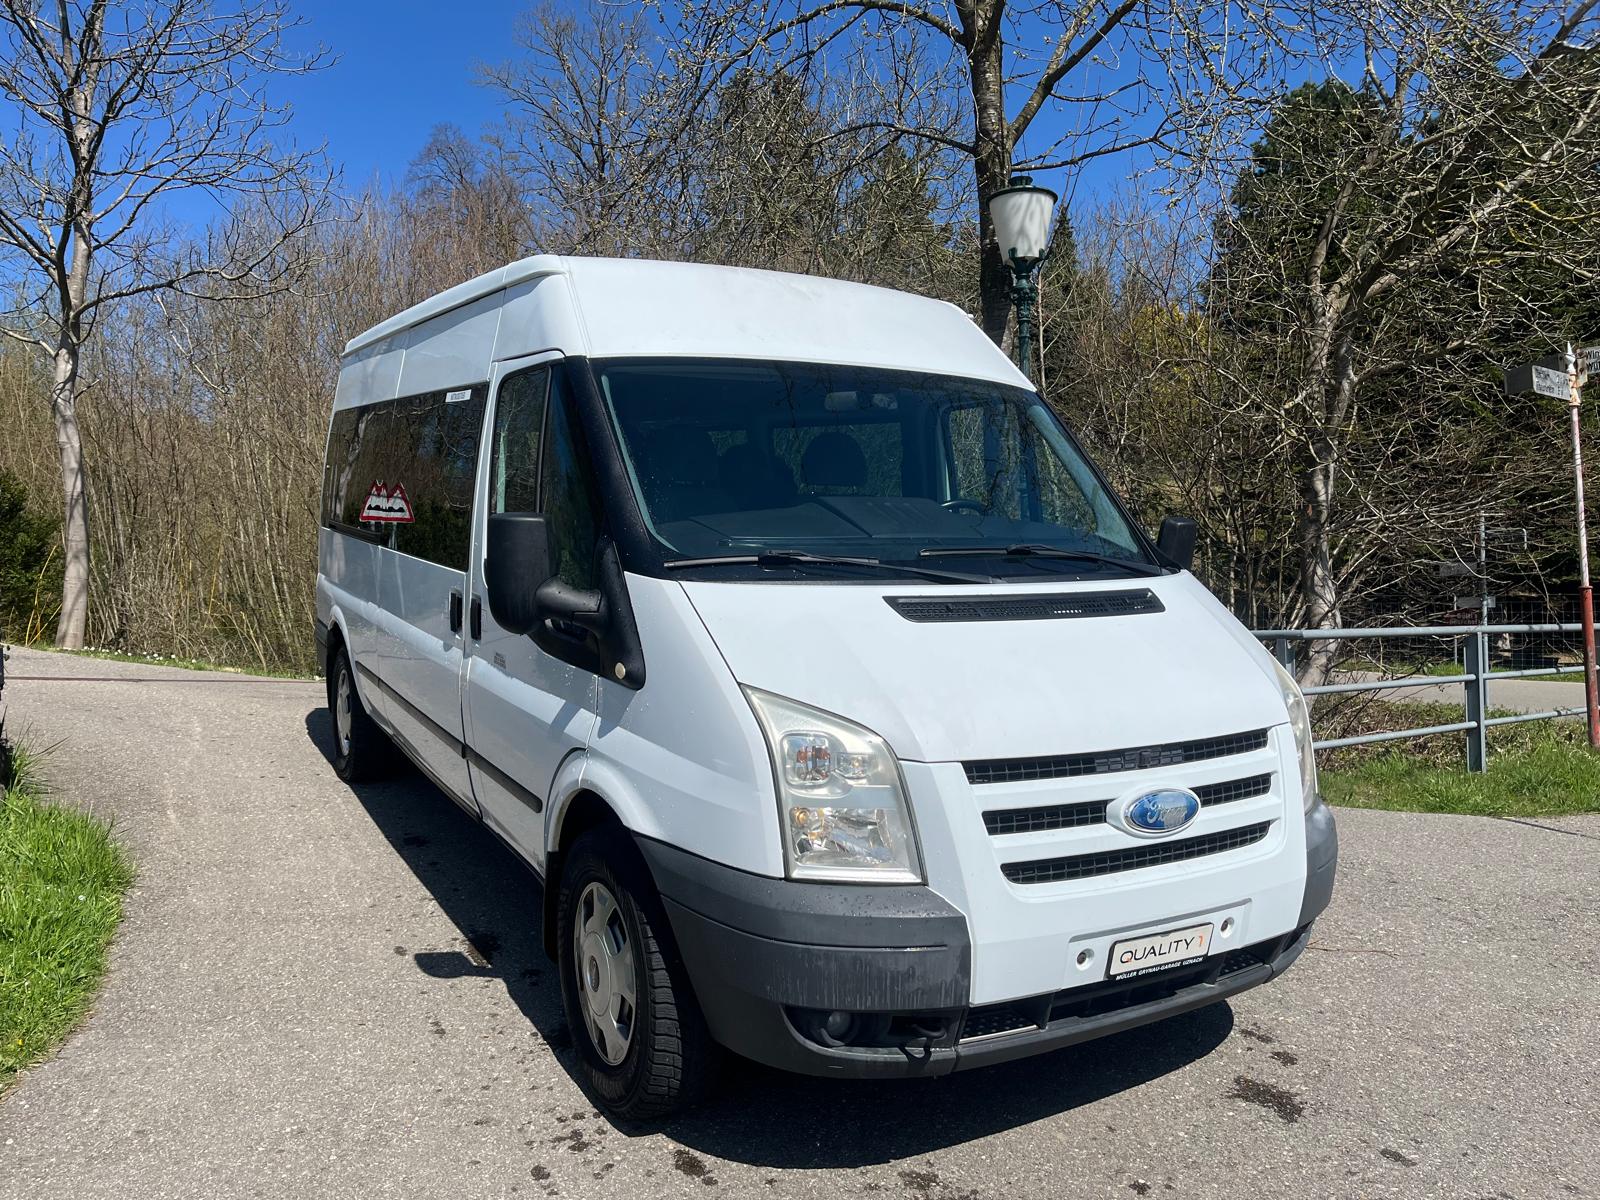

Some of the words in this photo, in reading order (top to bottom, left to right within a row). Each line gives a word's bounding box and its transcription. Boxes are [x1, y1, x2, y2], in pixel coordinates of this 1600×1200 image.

[1120, 936, 1195, 964] QUALITY
[1115, 971, 1137, 981] MÜLLER
[1182, 957, 1204, 966] UZNACH
